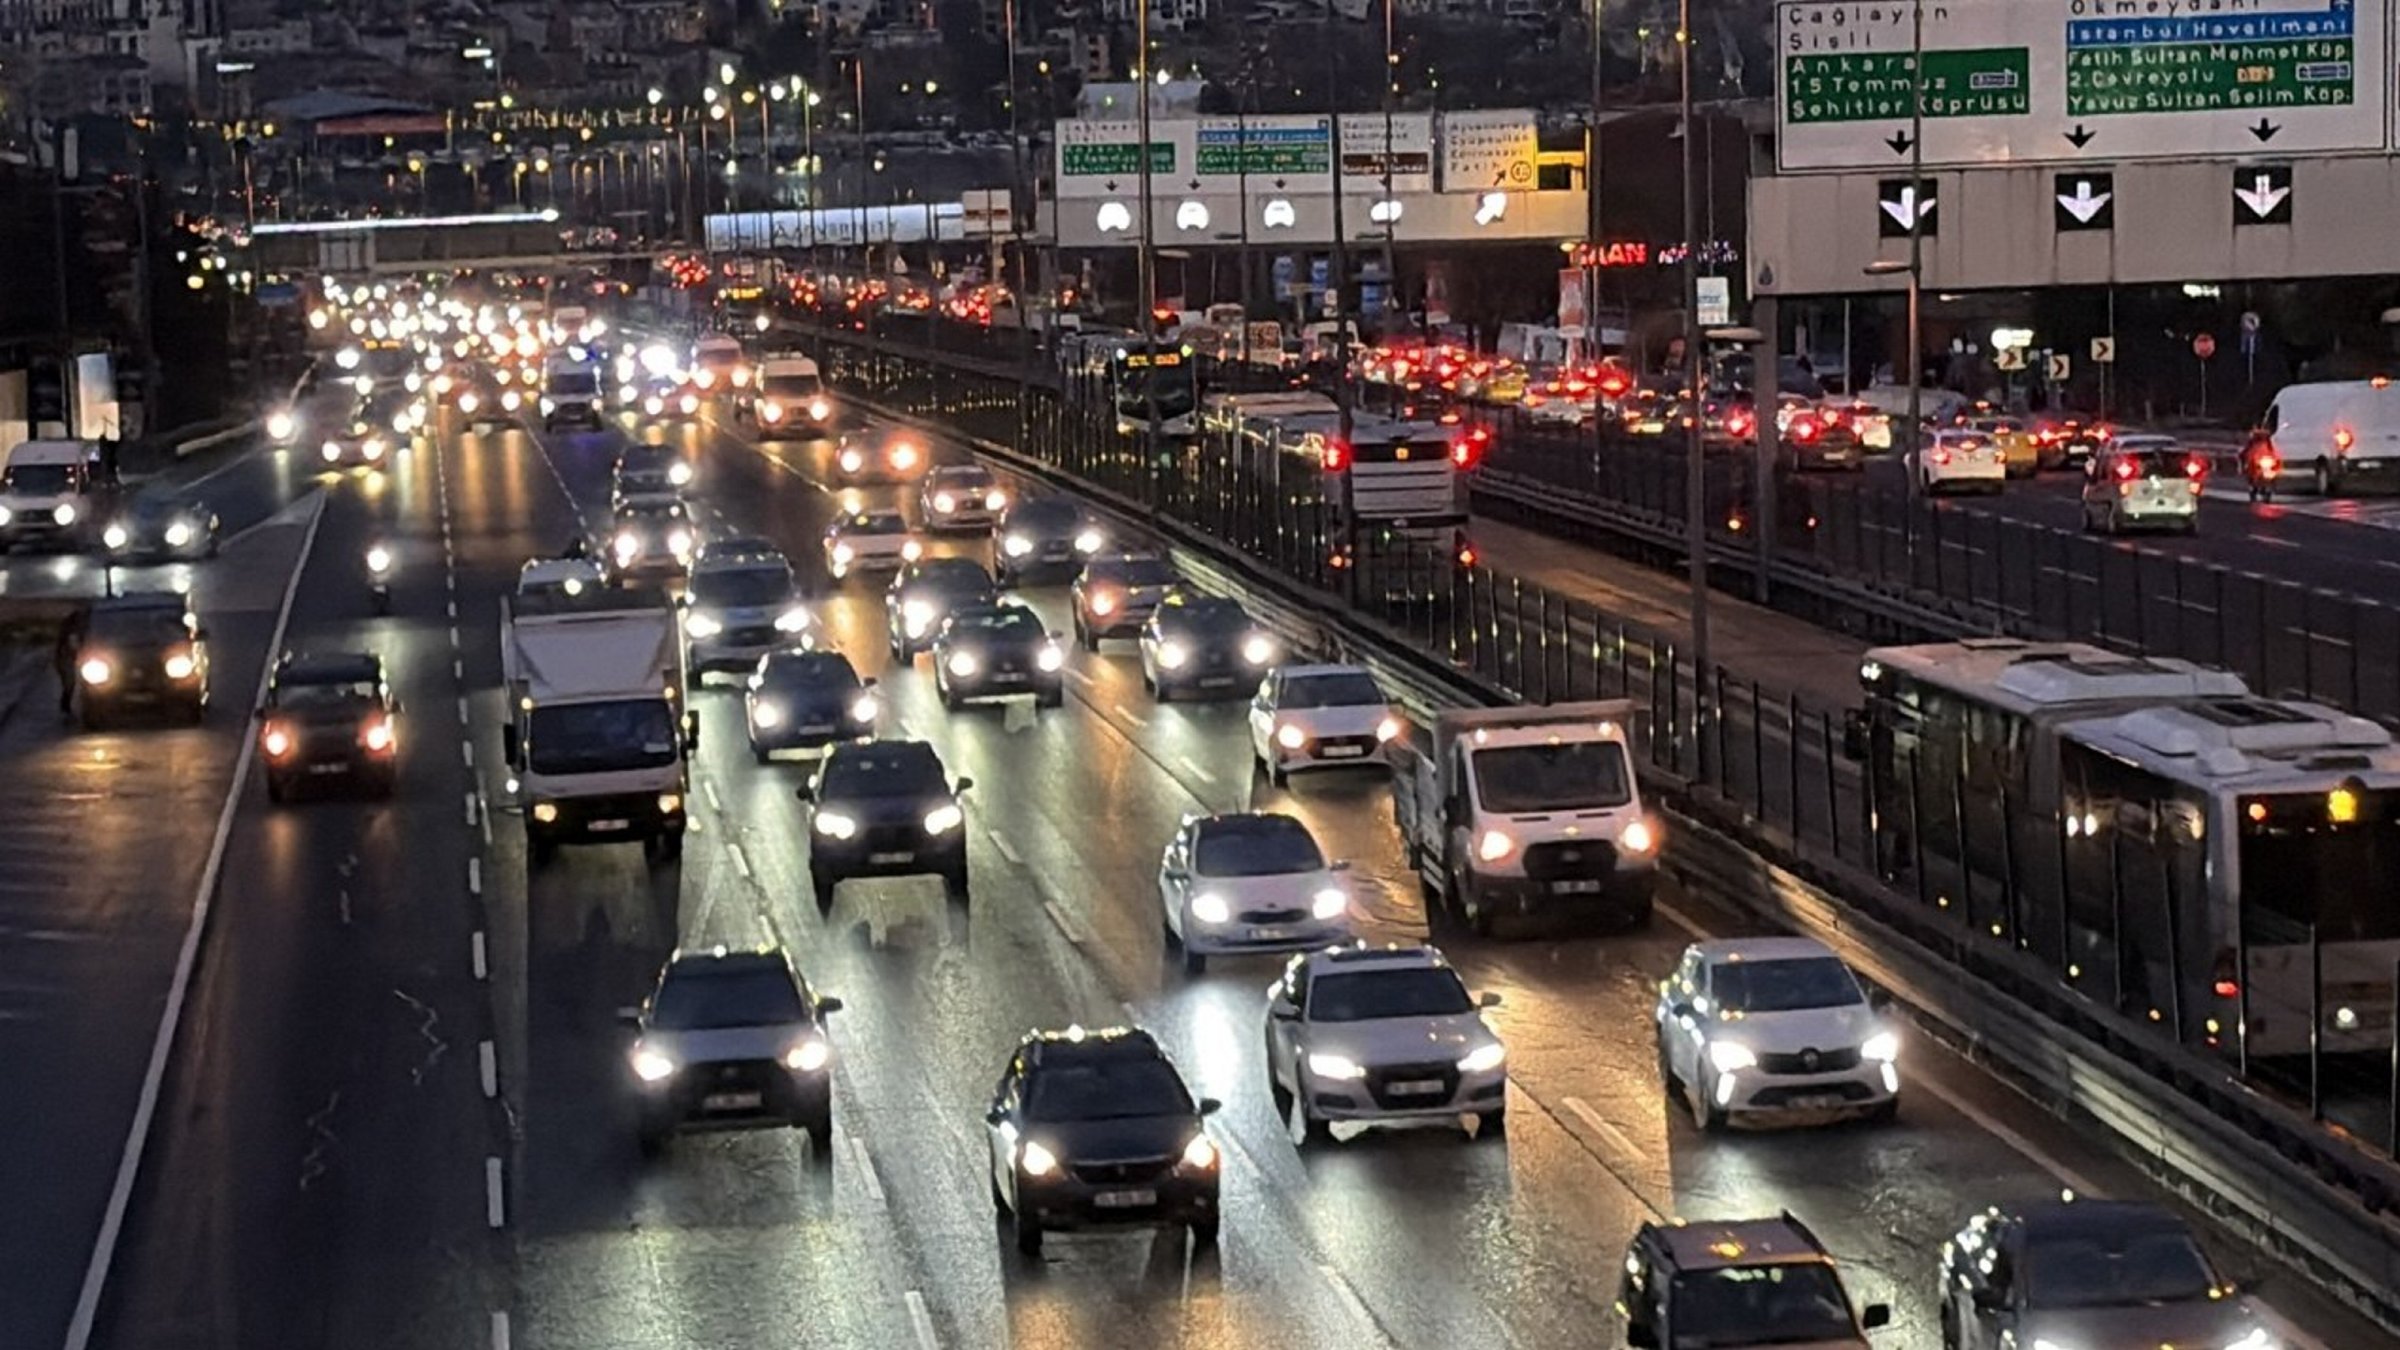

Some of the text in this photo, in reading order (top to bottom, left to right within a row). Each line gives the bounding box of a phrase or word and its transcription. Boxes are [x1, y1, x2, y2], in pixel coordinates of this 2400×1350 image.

[1791, 56, 1916, 74] Ankara
[2068, 50, 2123, 67] Fatih
[2130, 47, 2201, 66] Sultan
[2210, 44, 2298, 61] Mehmet
[1792, 76, 1945, 94] 15 Temmuz
[2069, 94, 2139, 111] Yavuz
[2145, 91, 2221, 108] Sultan
[2229, 87, 2294, 105] Selim
